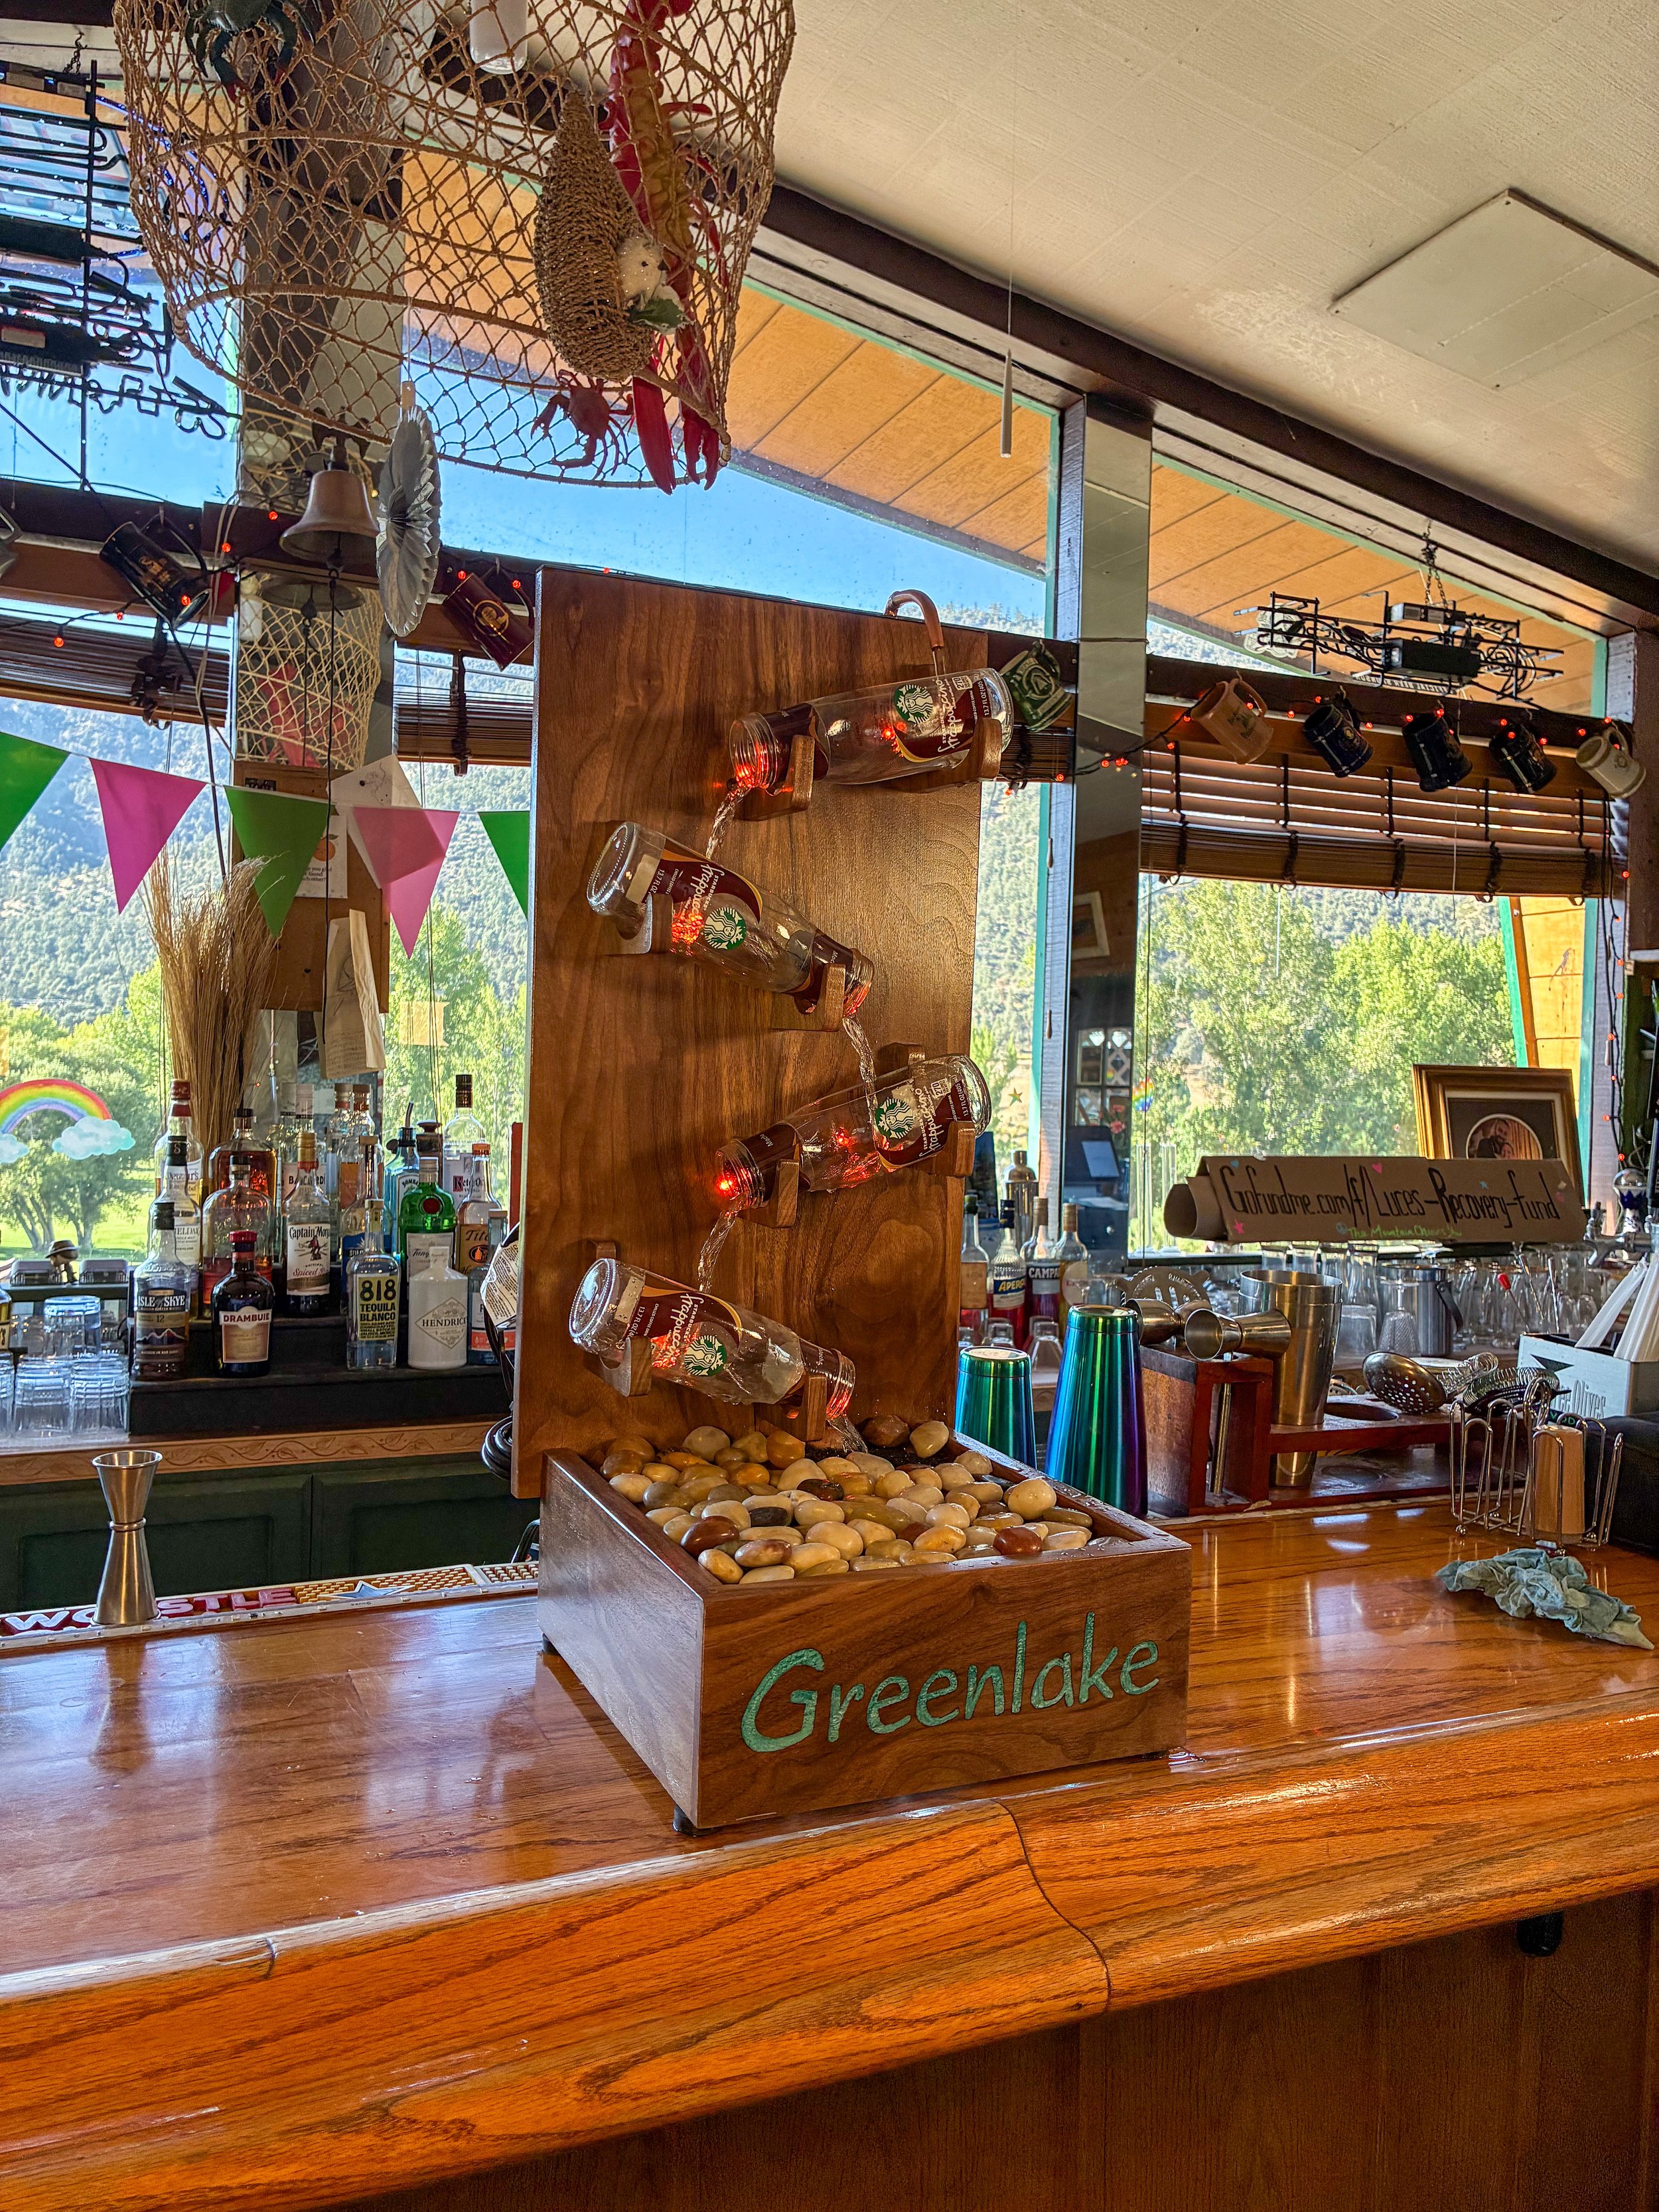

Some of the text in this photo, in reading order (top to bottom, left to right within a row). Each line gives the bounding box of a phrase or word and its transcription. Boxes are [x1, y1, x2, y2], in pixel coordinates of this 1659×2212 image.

[360, 1279, 396, 1302] 818
[138, 1295, 155, 1307] ISLE
[164, 1295, 185, 1307] SKYE
[360, 1303, 396, 1312] TEQUILA
[637, 1306, 646, 1317] 13.7
[223, 1312, 270, 1323] DRAMBUIE
[360, 1311, 396, 1322] BLANCO
[740, 1611, 1160, 1753] Greenlake
